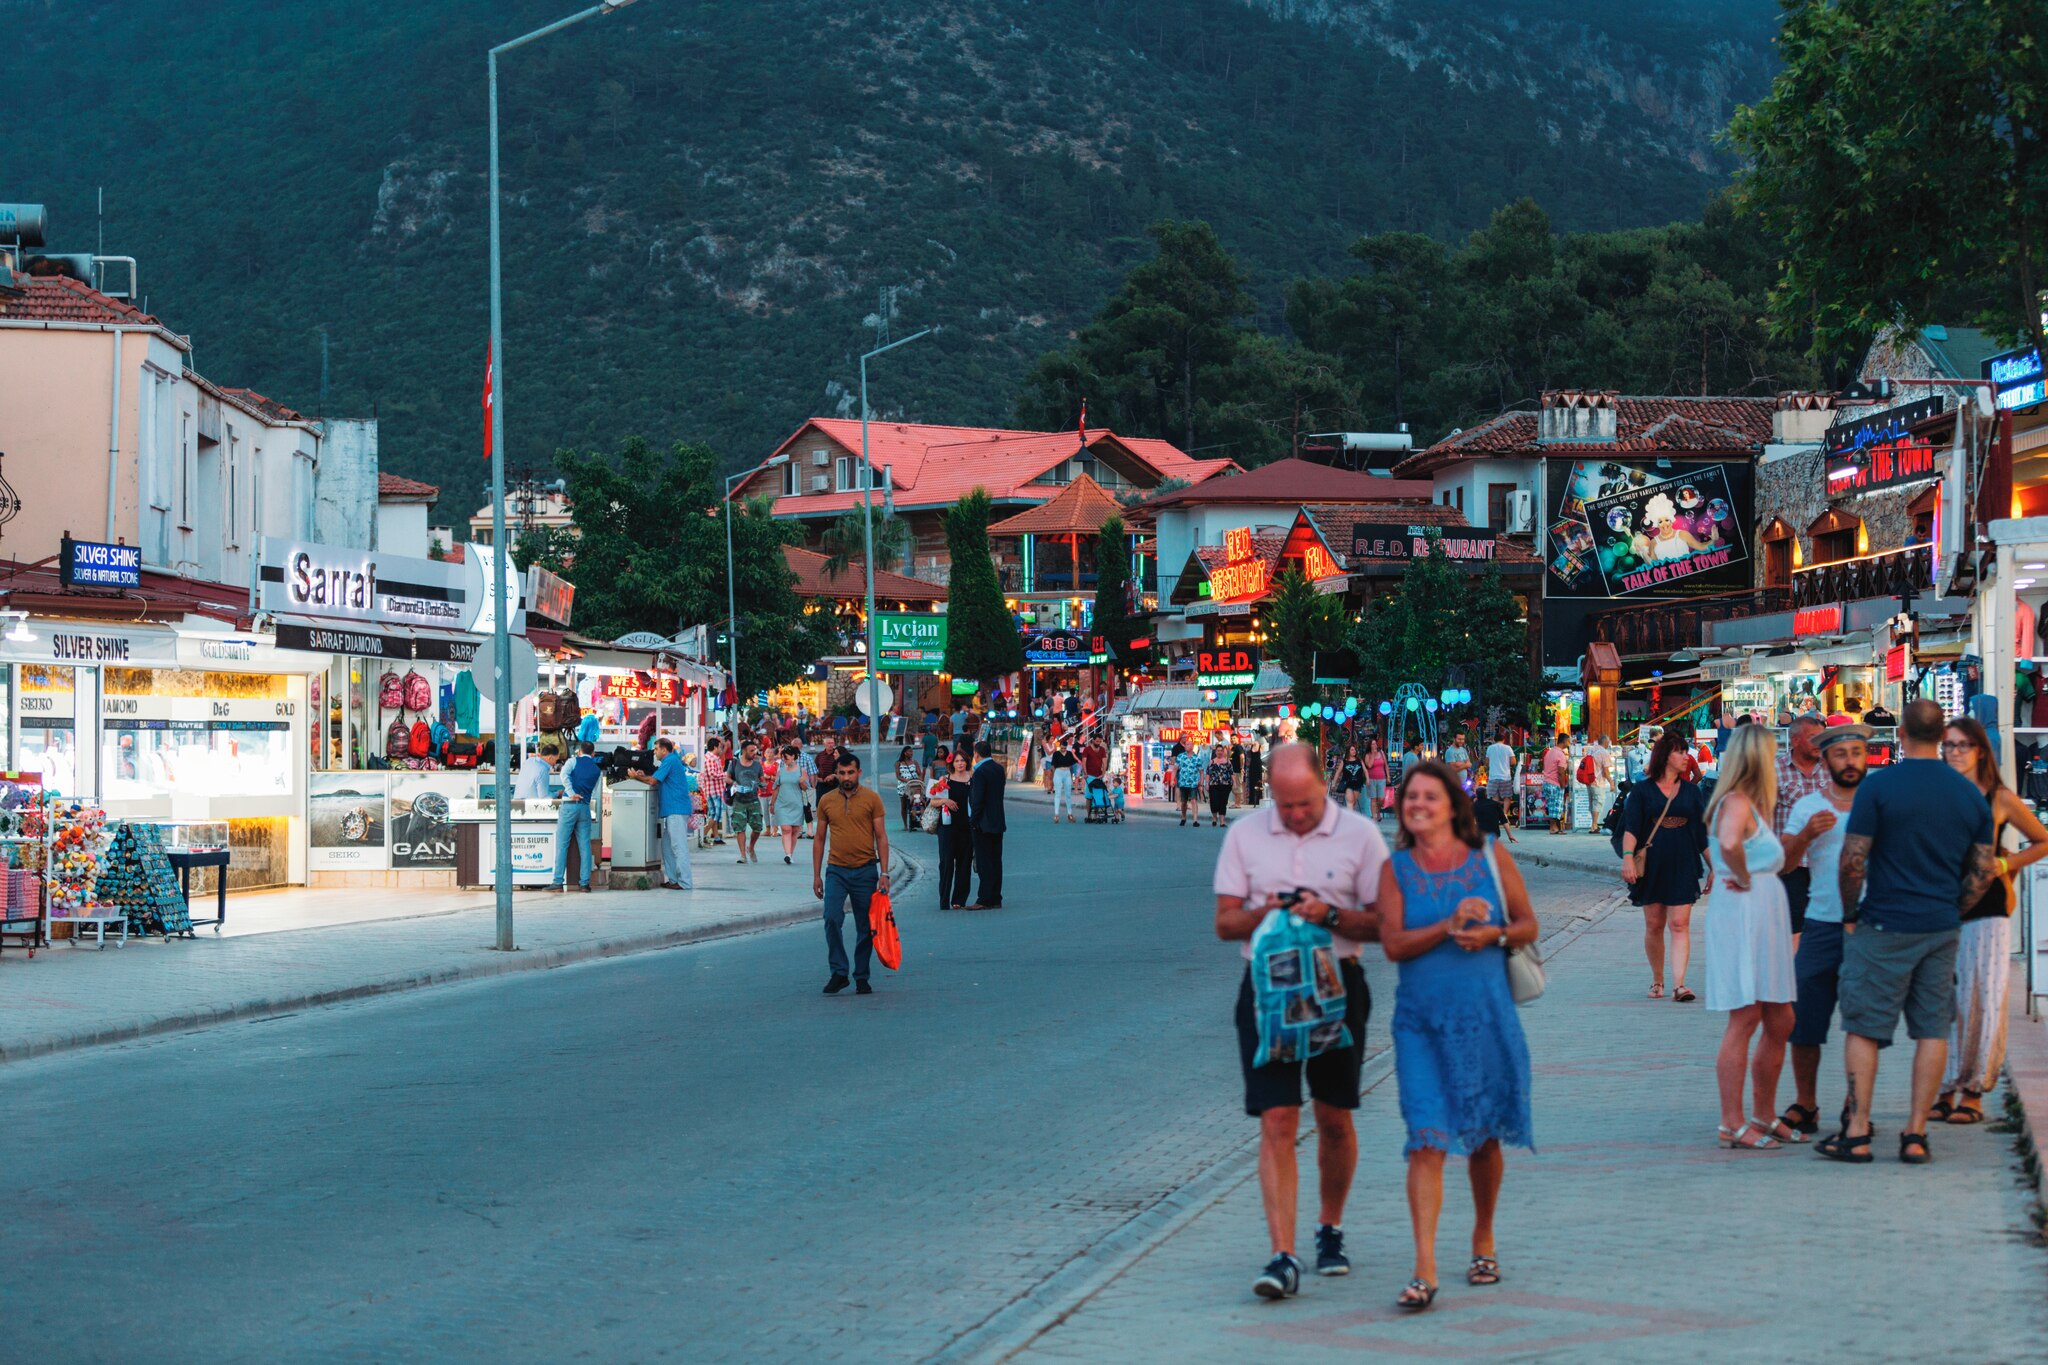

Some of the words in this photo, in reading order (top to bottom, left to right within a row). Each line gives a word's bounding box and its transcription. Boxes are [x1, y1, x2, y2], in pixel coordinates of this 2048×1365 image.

[1871, 444, 1893, 482] THE
[1896, 437, 1933, 476] TOWN
[1587, 504, 1597, 512] THE
[1597, 499, 1619, 509] ORIGINAL
[1619, 492, 1639, 503] COMEDY
[1639, 487, 1659, 499] VARIETY
[1659, 483, 1673, 494] SHOW
[1673, 480, 1684, 489] FOR
[1684, 477, 1693, 486] ALL
[1693, 474, 1703, 484] THE
[1703, 469, 1721, 480] FAMILY
[74, 545, 108, 565] SILVER
[110, 547, 138, 568] SHINE
[1355, 538, 1407, 557] R.E.D.
[1413, 537, 1496, 560] RETAURANT
[74, 568, 92, 580] SILVER
[92, 569, 97, 581] &
[97, 569, 120, 583] NATURAL
[120, 571, 138, 584] STONE
[1622, 570, 1651, 591] TALK
[1652, 566, 1669, 582] OF
[1669, 559, 1694, 578] THE
[1694, 550, 1729, 571] TOWN
[291, 552, 376, 609] Sarraf
[1211, 559, 1267, 601] RESTAURANT
[882, 619, 939, 640] Lycian
[53, 634, 93, 660] SILVER
[96, 637, 129, 661] SHINE
[310, 630, 343, 650] SARRAF
[344, 634, 383, 654] DIAMOND
[909, 636, 940, 647] Center
[1042, 637, 1078, 650] RED
[1199, 651, 1253, 672] R.E.D.
[611, 676, 630, 687] WE
[607, 685, 637, 698] PLUS
[20, 697, 53, 711] SEIKO
[103, 699, 138, 714] IAMOND
[213, 702, 230, 716] D&G
[275, 703, 295, 716] GOLD
[328, 851, 360, 859] SEIKO
[393, 842, 456, 856] GAN
